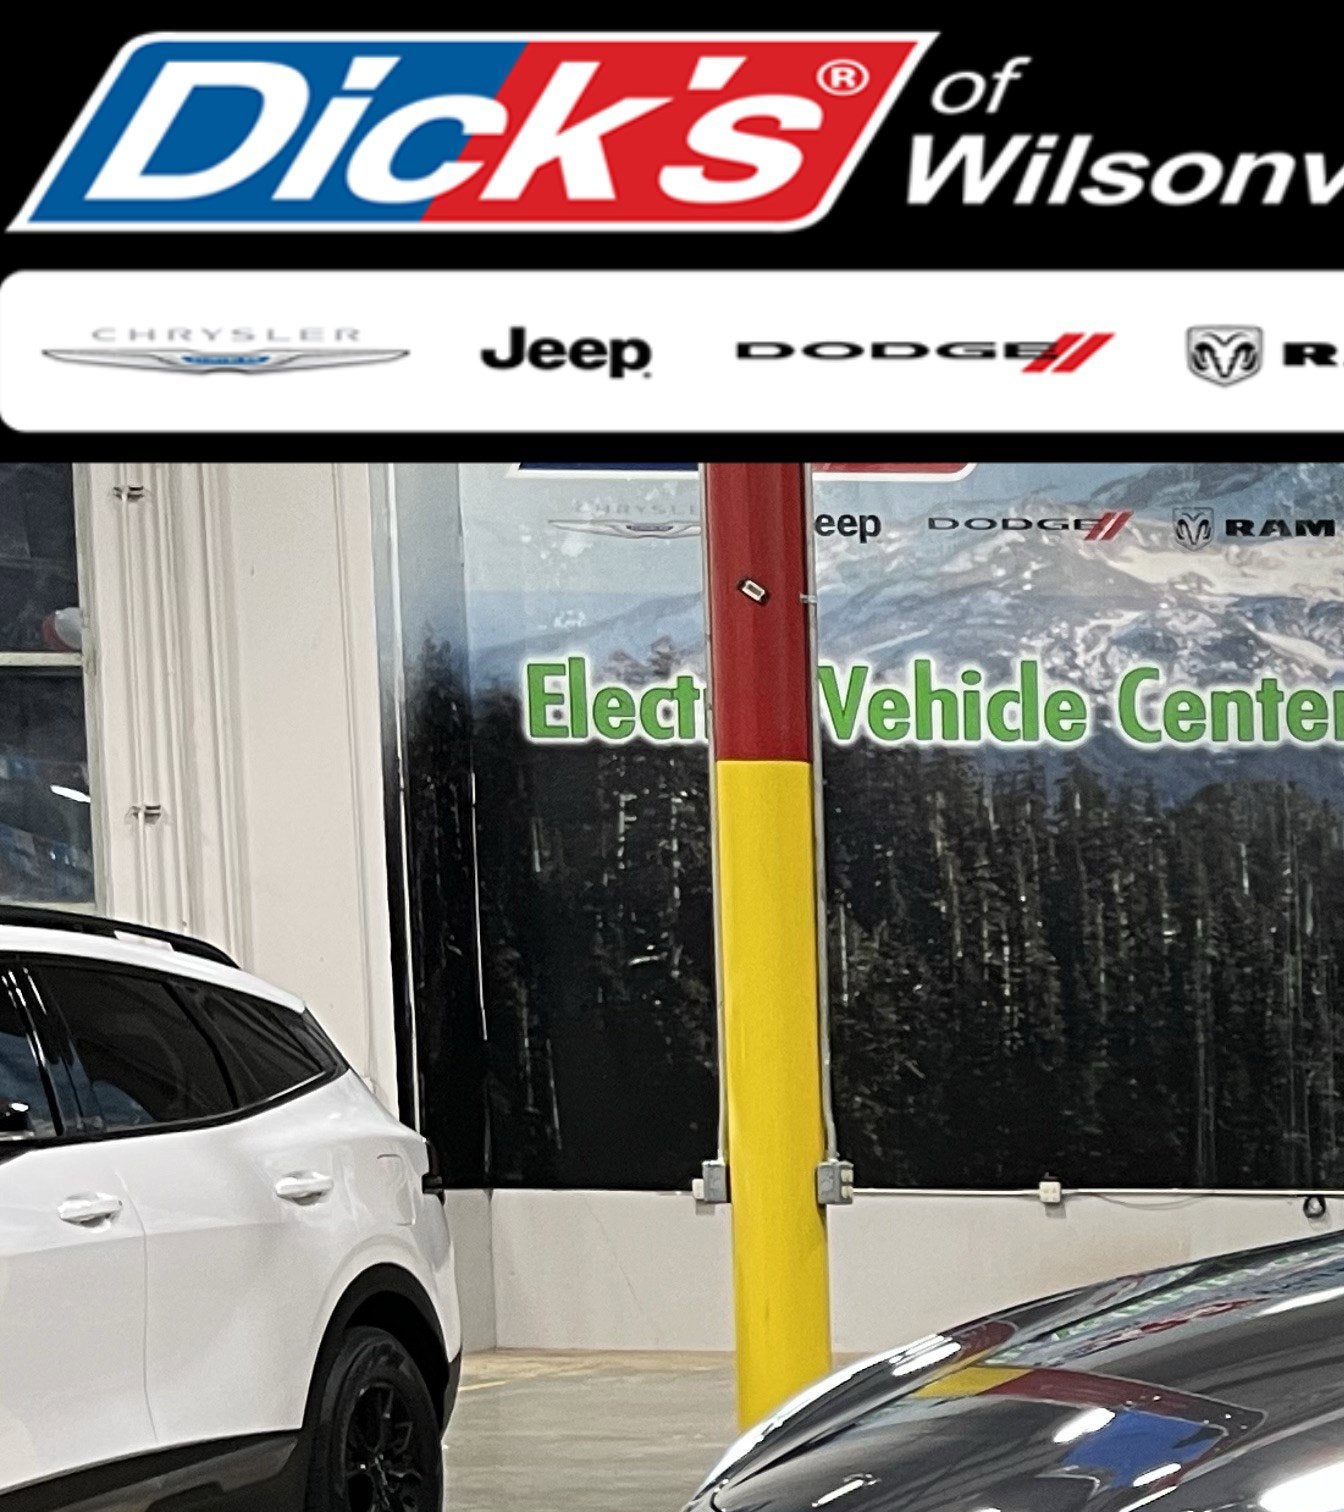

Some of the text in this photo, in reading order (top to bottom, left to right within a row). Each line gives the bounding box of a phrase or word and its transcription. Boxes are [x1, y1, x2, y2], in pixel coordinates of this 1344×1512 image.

[572, 503, 701, 515] CHRYSLE
[814, 512, 882, 544] eep
[927, 516, 1103, 531] DODGE
[1225, 518, 1336, 537] RAM
[525, 657, 709, 741] Elect
[817, 660, 1088, 743] Vehicle
